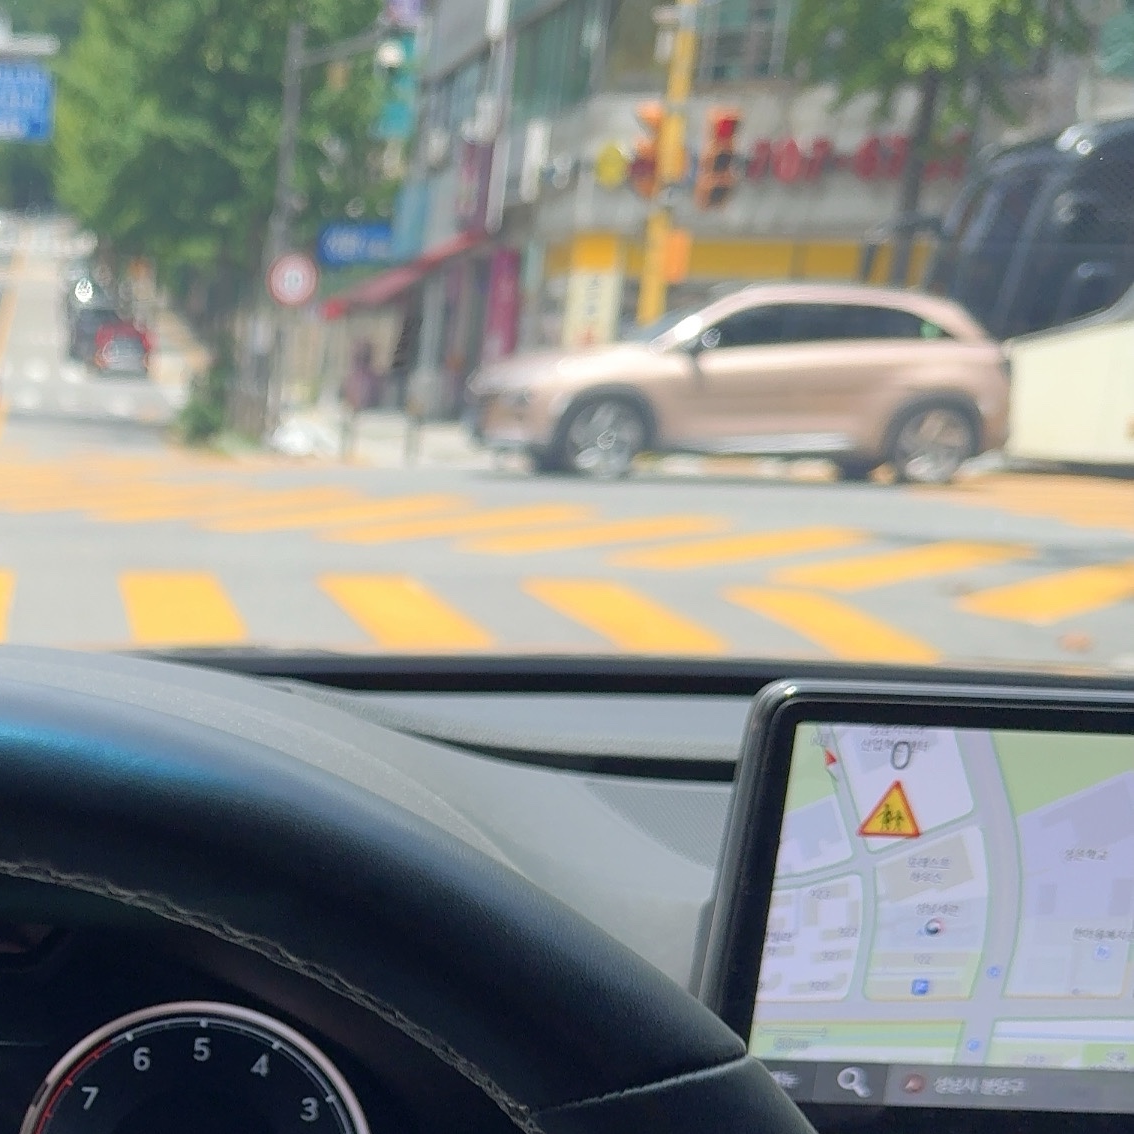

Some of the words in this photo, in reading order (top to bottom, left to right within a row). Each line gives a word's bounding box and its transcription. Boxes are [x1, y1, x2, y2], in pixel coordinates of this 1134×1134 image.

[132, 1047, 151, 1071] 6
[192, 1037, 212, 1061] 5
[250, 1054, 270, 1077] 4
[81, 1086, 99, 1110] 7
[299, 1097, 319, 1122] 3
